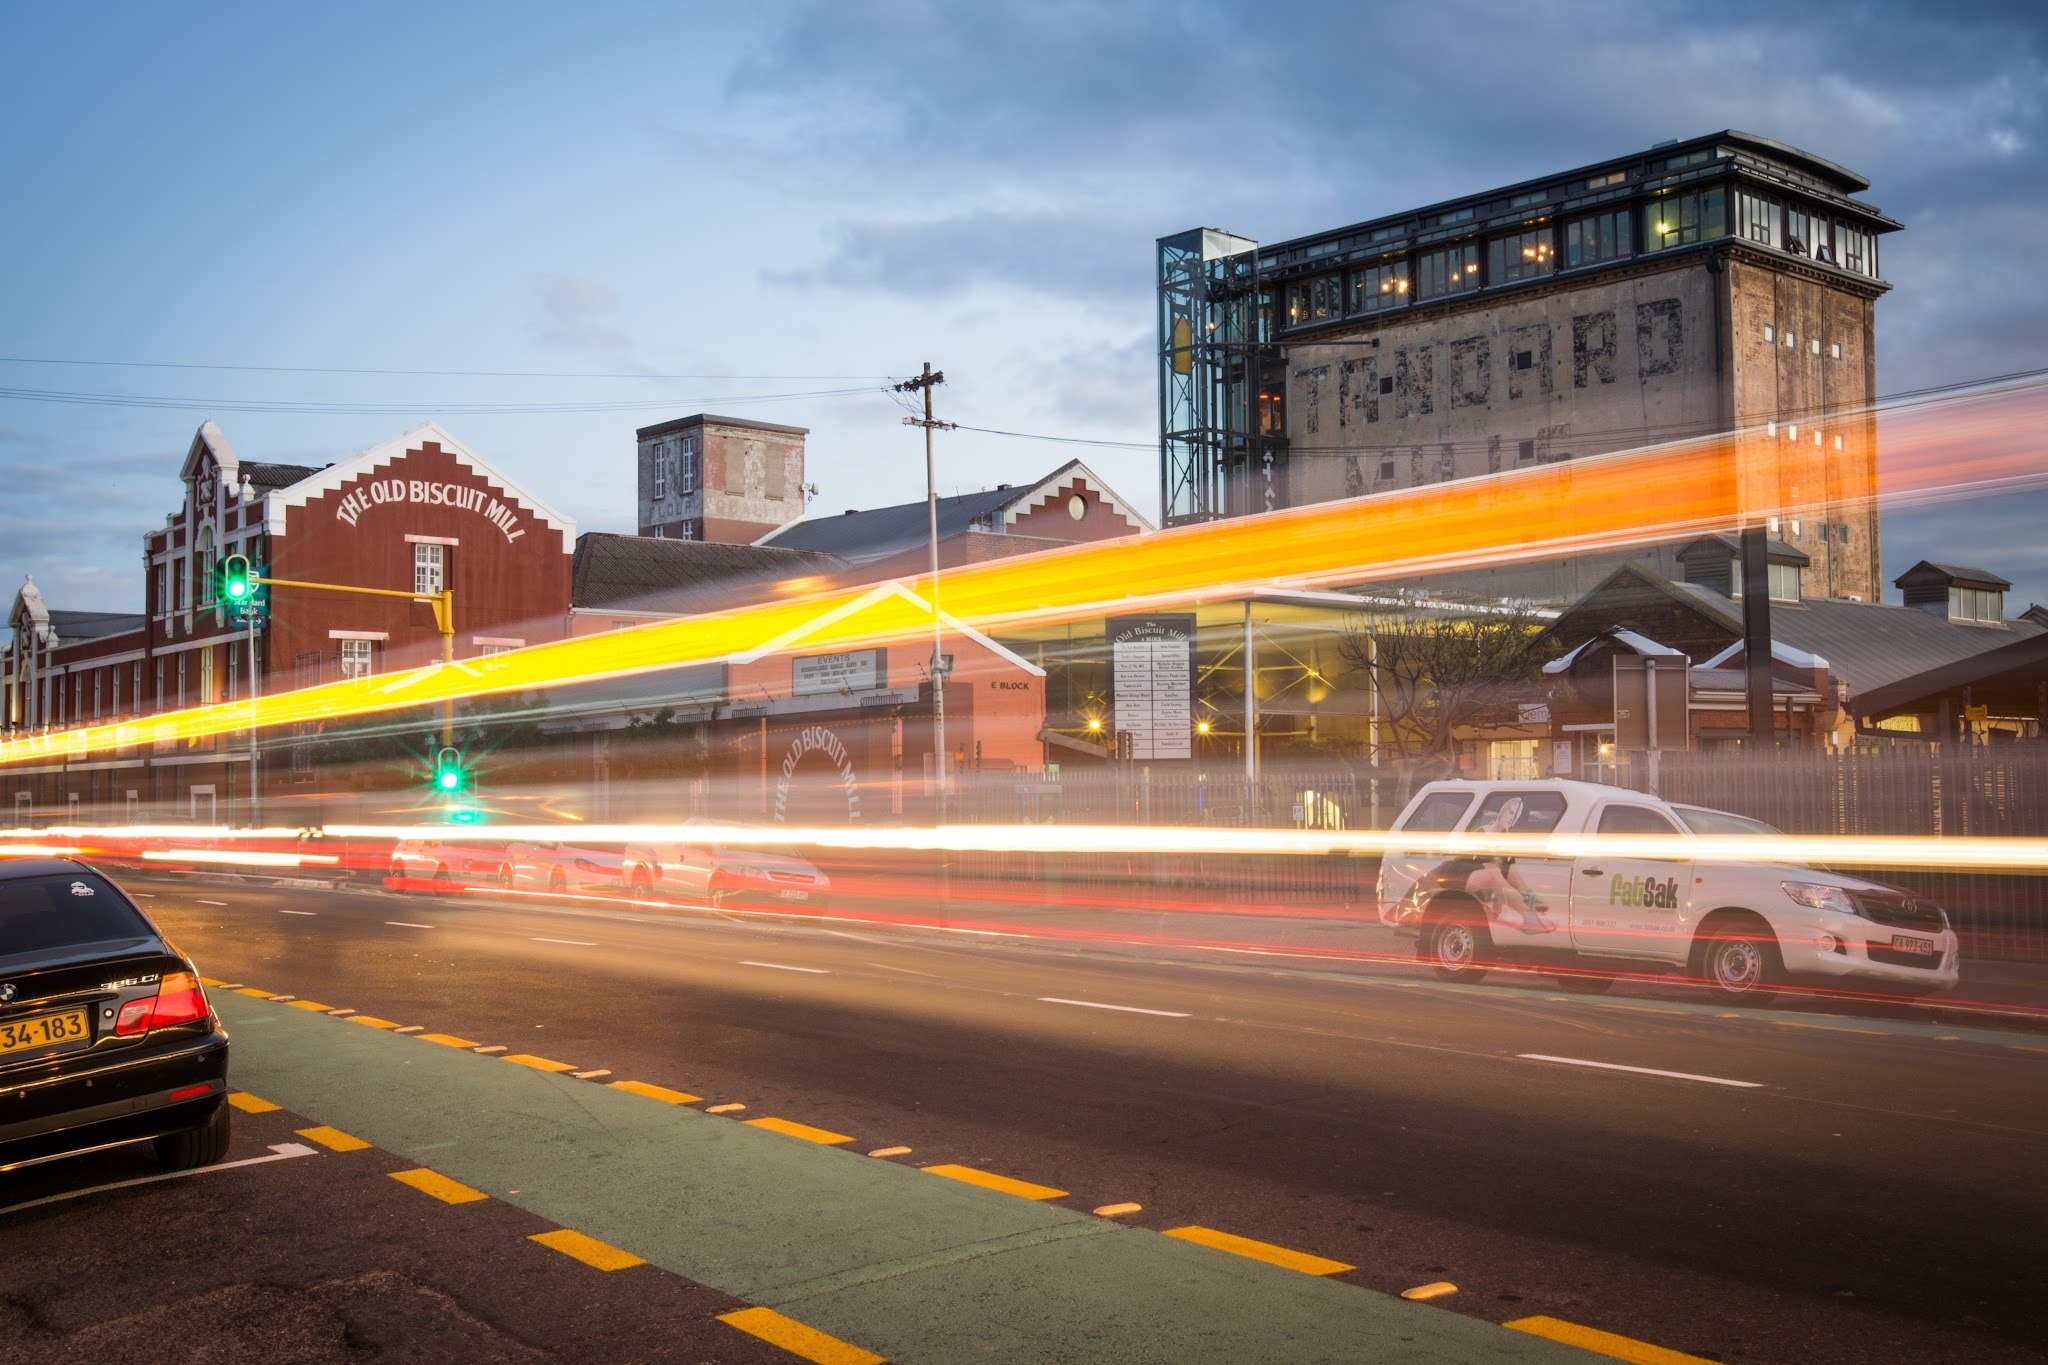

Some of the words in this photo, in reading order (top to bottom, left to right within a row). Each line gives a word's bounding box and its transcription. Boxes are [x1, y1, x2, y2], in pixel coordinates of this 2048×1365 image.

[336, 486, 372, 527] THE
[370, 479, 406, 504] OLD
[409, 480, 487, 513] BISCUIT
[483, 498, 526, 544] MILL
[1115, 630, 1133, 643] Old
[1134, 625, 1165, 635] Biscuit
[1167, 628, 1187, 642] Mill
[818, 653, 850, 664] EVENTS
[991, 681, 997, 689] E
[1000, 682, 1029, 690] BLOCK
[775, 777, 788, 822] THE
[783, 738, 802, 779] OLD
[801, 726, 847, 768] BISCUIT
[841, 760, 861, 825] MILL
[0, 1014, 82, 1048] 34-183
